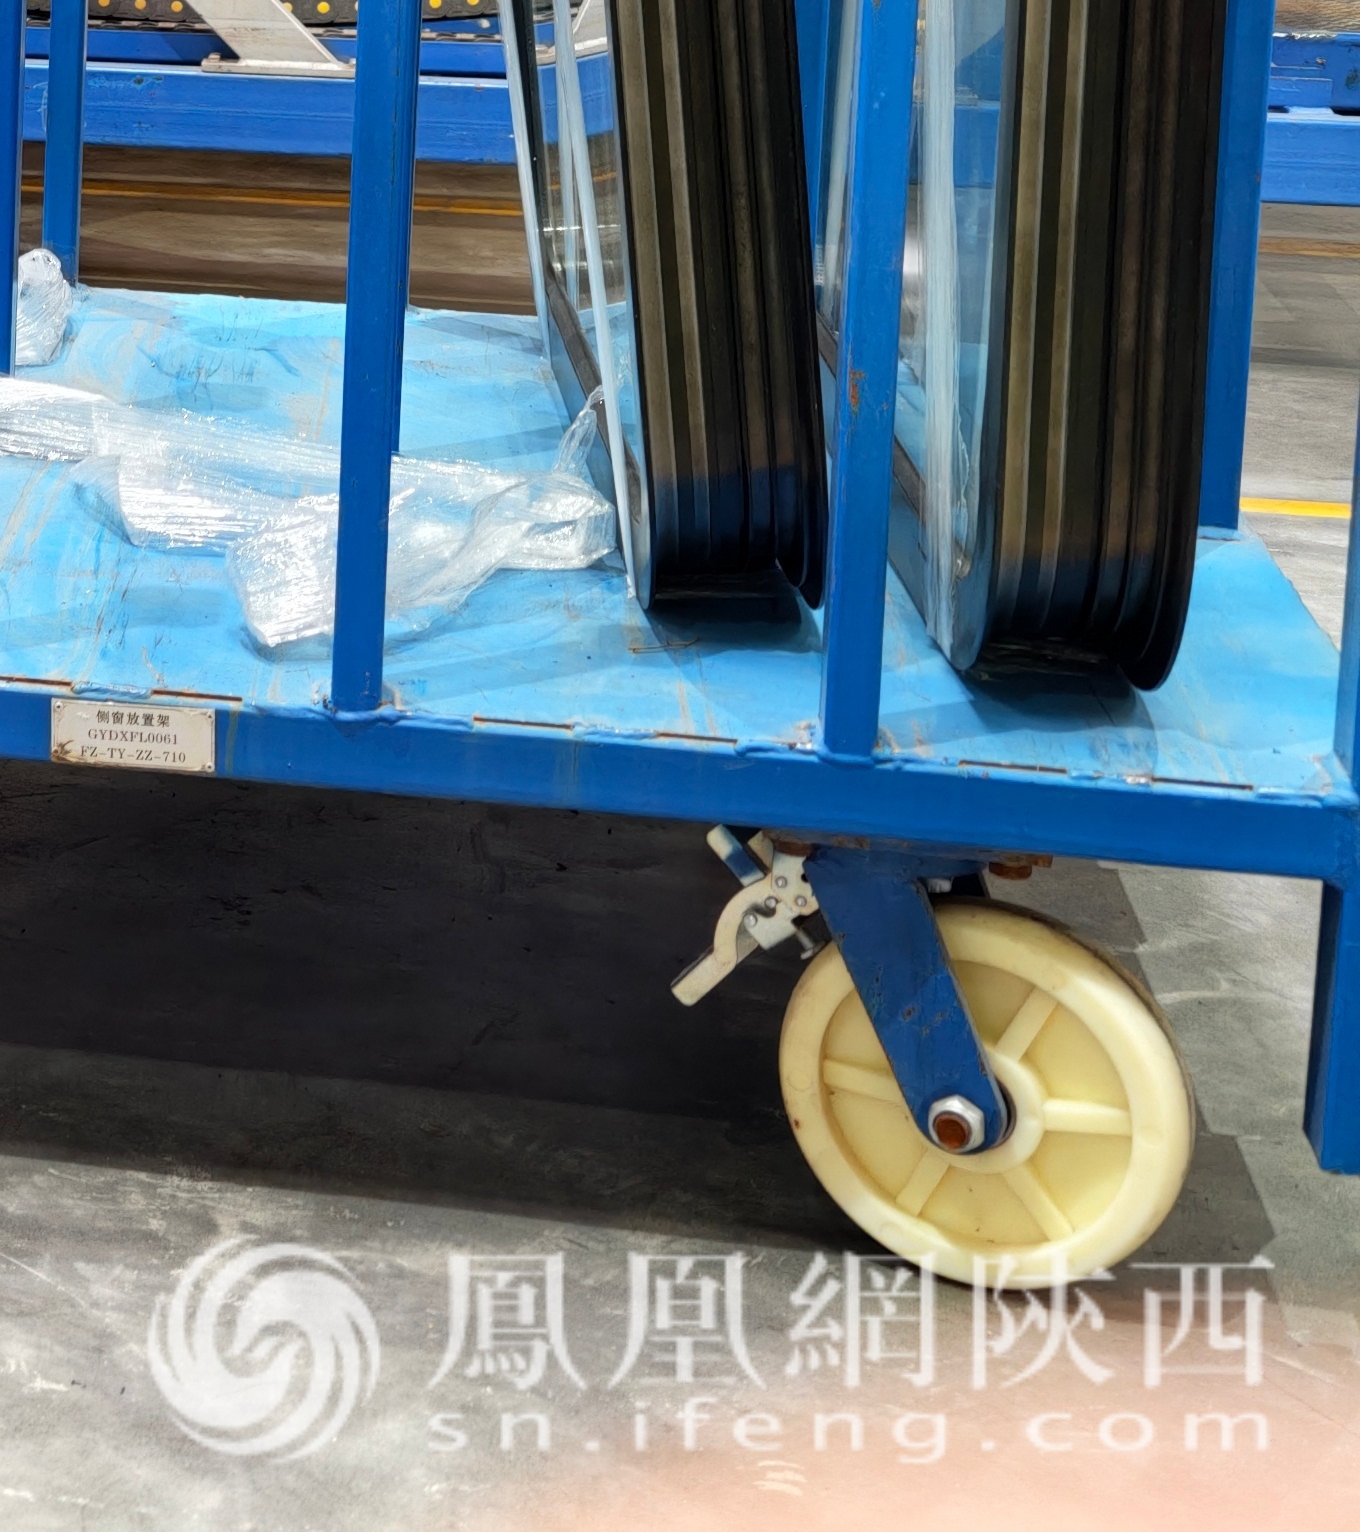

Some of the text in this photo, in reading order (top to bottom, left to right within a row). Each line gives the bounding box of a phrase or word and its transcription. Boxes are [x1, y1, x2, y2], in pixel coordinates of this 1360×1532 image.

[96, 709, 171, 728] 侧窗放置架
[87, 728, 178, 745] GYDXFL0061
[80, 745, 187, 764] FZ-TY-ZZ-710
